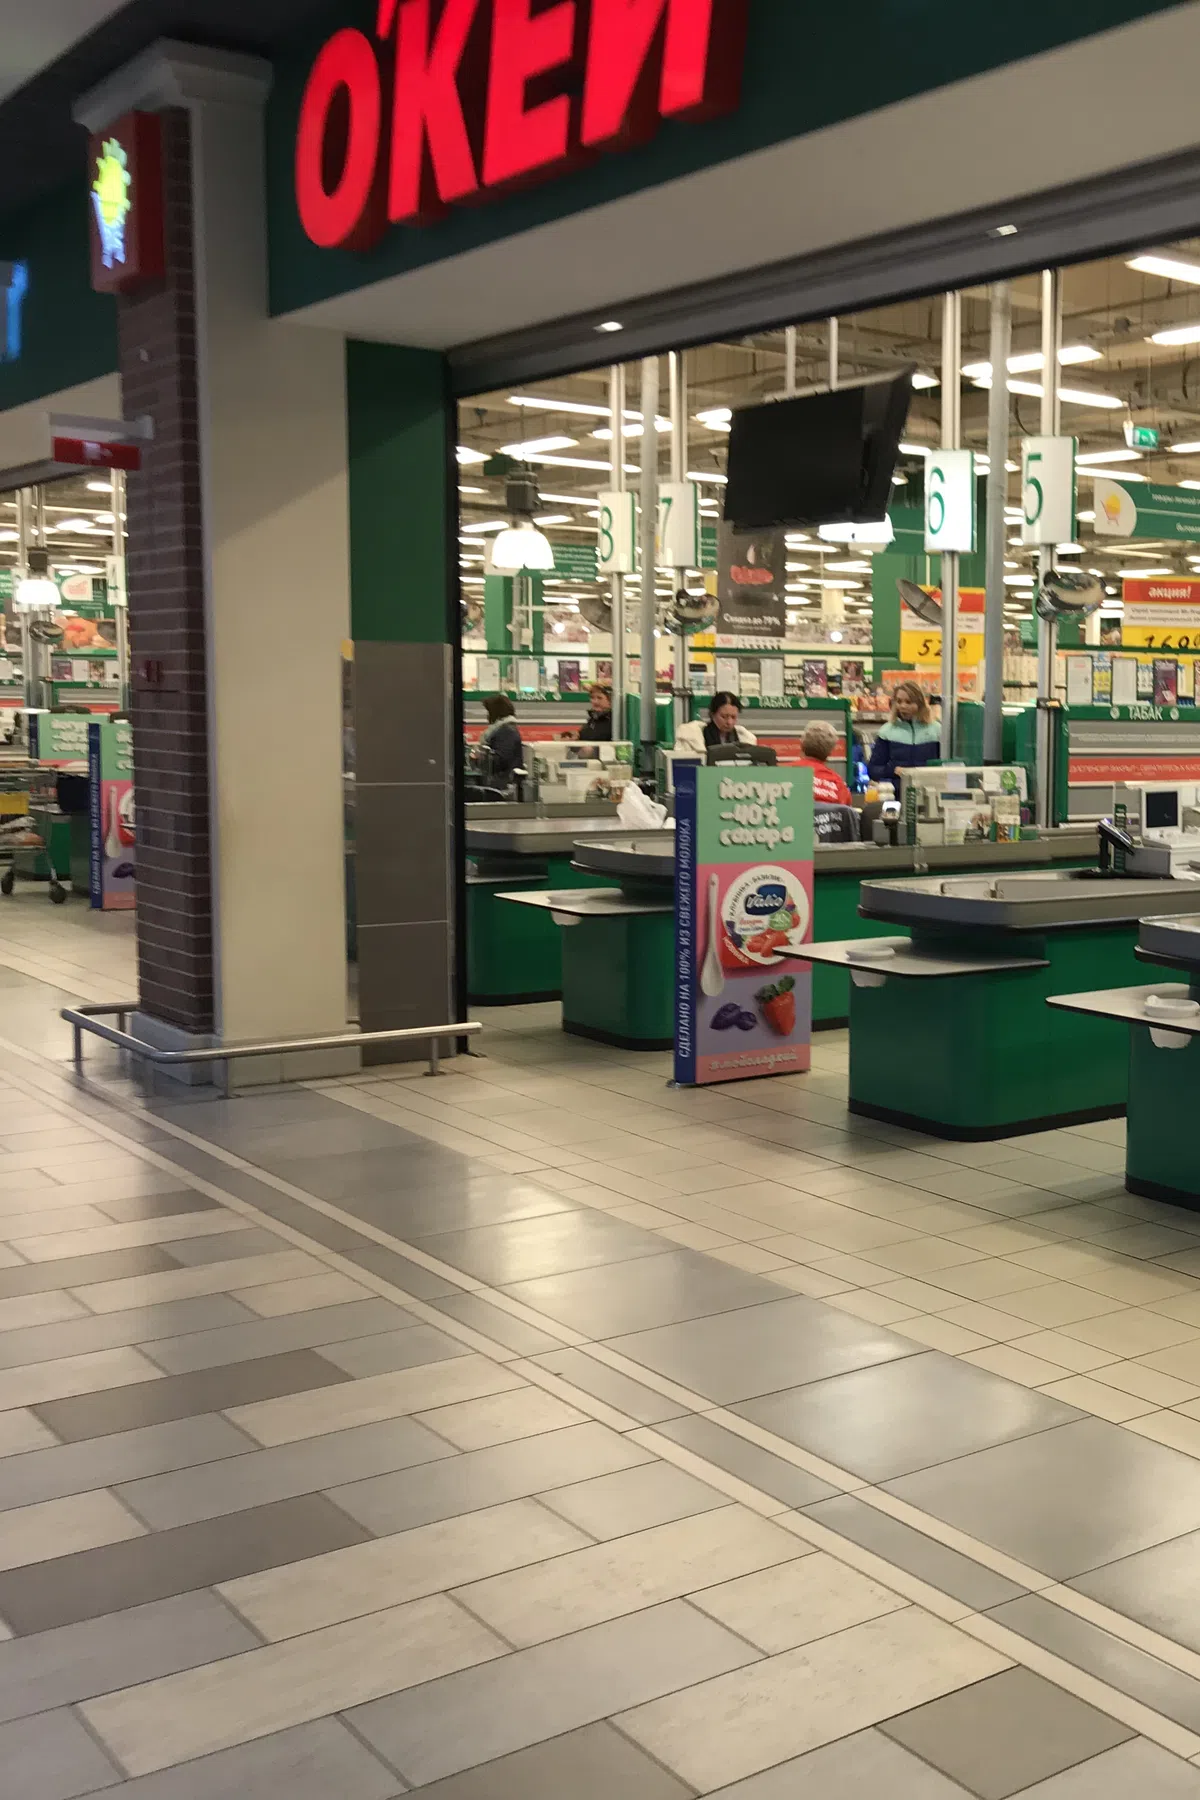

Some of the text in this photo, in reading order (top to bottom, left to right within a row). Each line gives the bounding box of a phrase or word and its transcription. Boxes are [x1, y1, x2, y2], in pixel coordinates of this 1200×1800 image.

[928, 466, 945, 535] 6
[1023, 452, 1043, 526] 5
[660, 496, 673, 556] 7
[1148, 585, 1192, 599] акция!
[1127, 704, 1164, 721] ТАБАК
[720, 803, 781, 827] -40%
[719, 826, 795, 850] сахара
[746, 892, 783, 909] Valio
[679, 817, 691, 1058] СДЕЛАНО НА 100% ИЗ СВЕЖЕГО МОЛОКА
